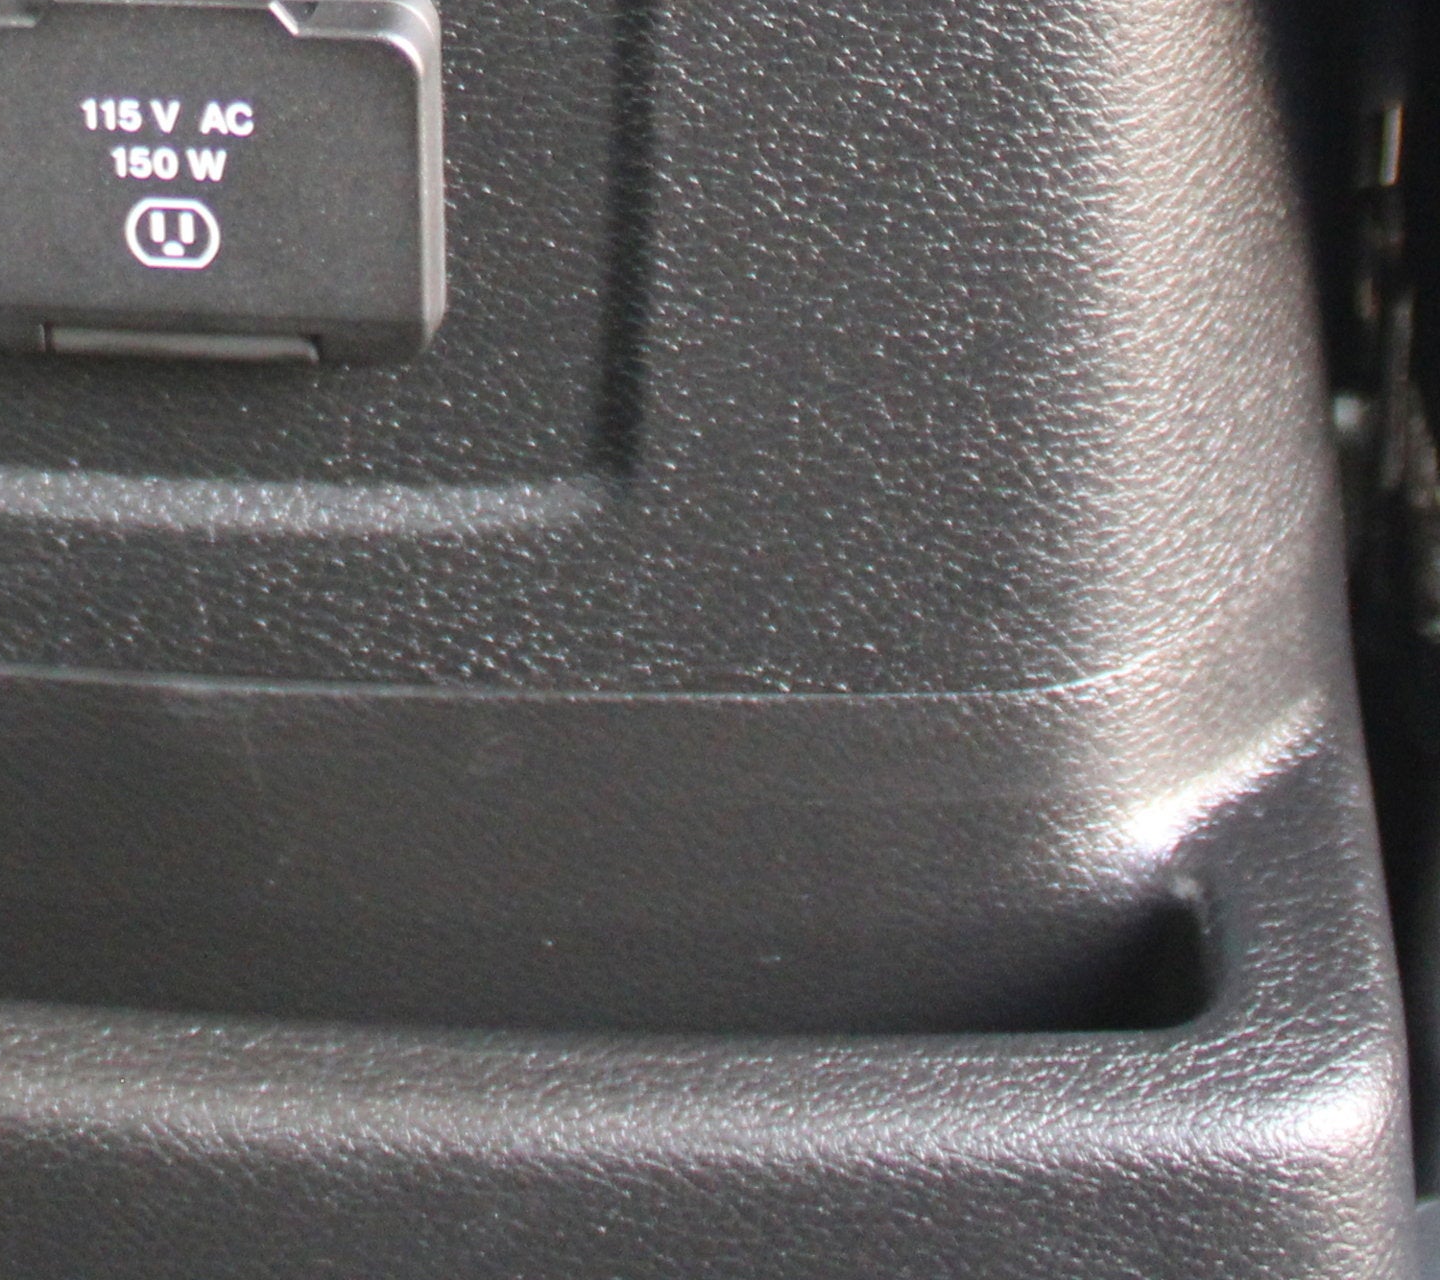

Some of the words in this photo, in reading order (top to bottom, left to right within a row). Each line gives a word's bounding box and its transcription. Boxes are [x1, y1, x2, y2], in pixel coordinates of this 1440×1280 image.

[79, 96, 144, 133] 115
[149, 97, 182, 135] V
[198, 99, 255, 137] AC
[109, 144, 180, 181] 150
[184, 146, 229, 183] W
